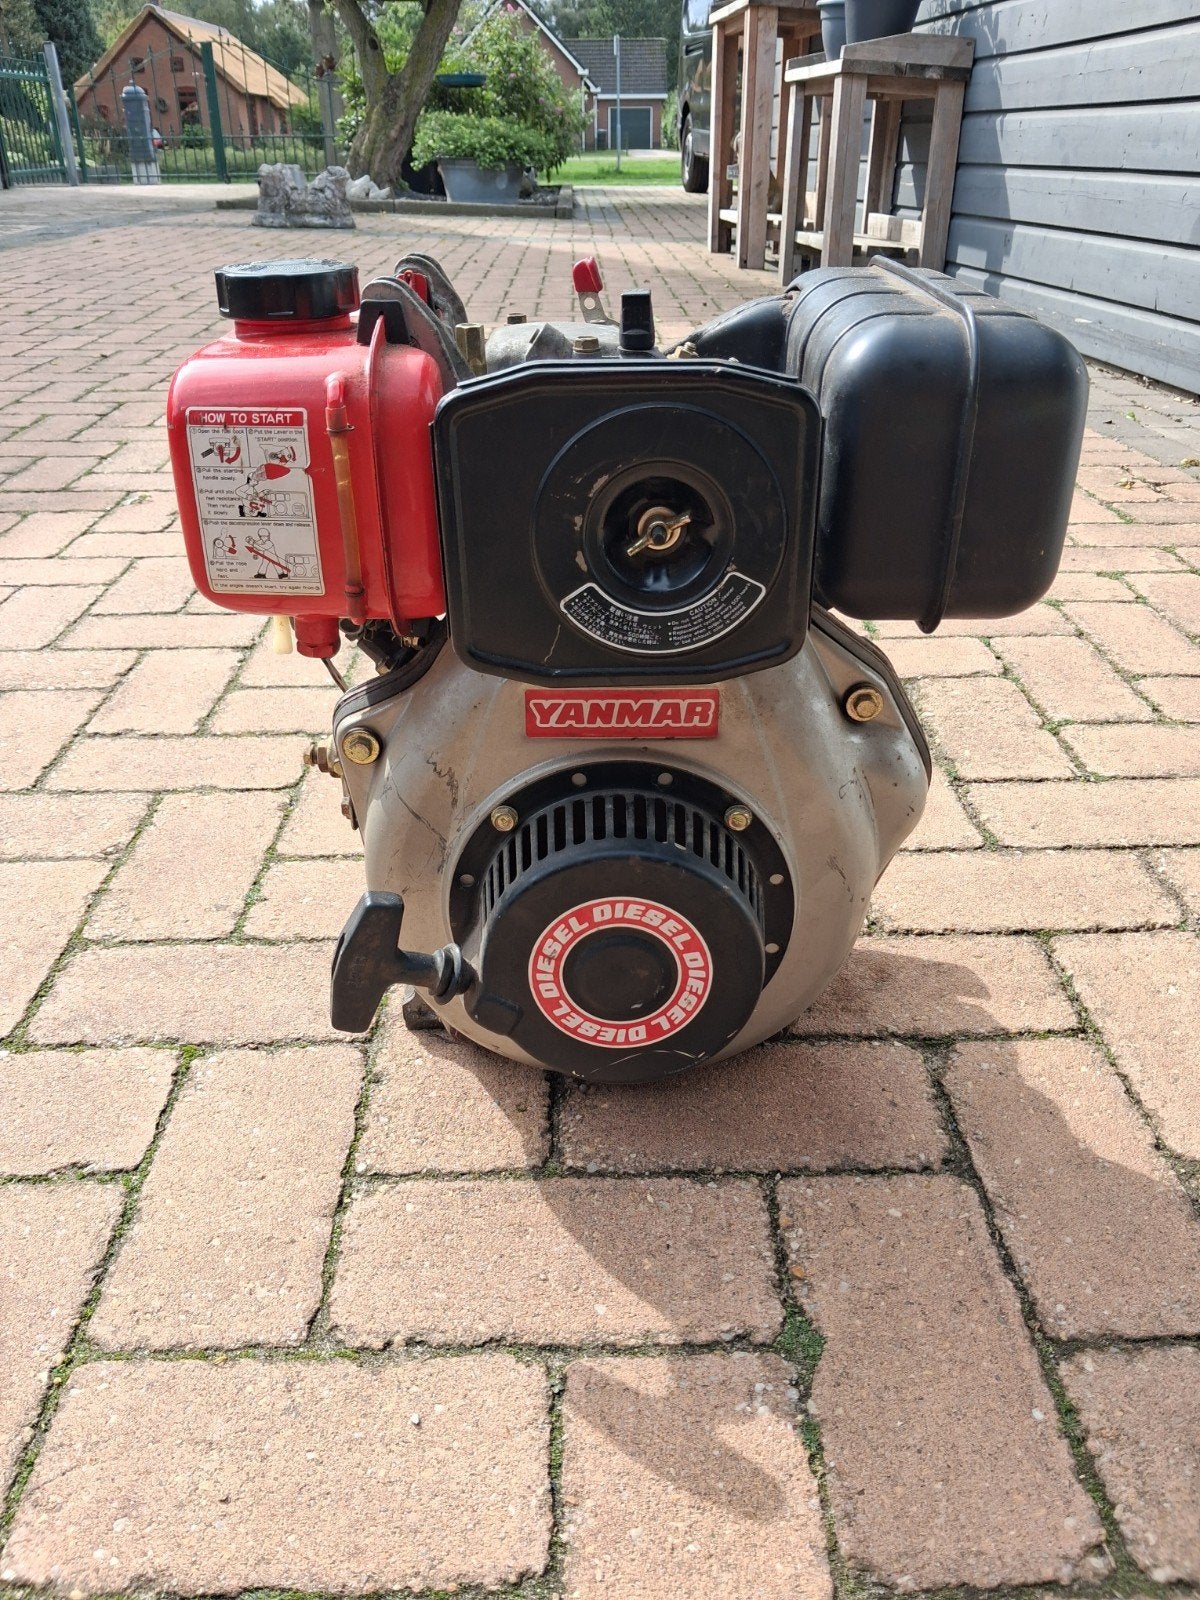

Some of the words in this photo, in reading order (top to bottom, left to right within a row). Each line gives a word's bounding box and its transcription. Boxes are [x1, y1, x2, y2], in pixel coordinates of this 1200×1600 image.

[200, 413, 225, 423] HOW
[231, 413, 247, 423] TO
[252, 413, 292, 424] START
[689, 597, 717, 616] CAUTION
[731, 595, 741, 605] 500
[529, 699, 715, 728] YANMAR
[592, 902, 692, 951] DIESEL
[536, 916, 590, 998] DIESEL
[651, 951, 706, 1030] DIESEL
[552, 999, 647, 1042] DIESEL
